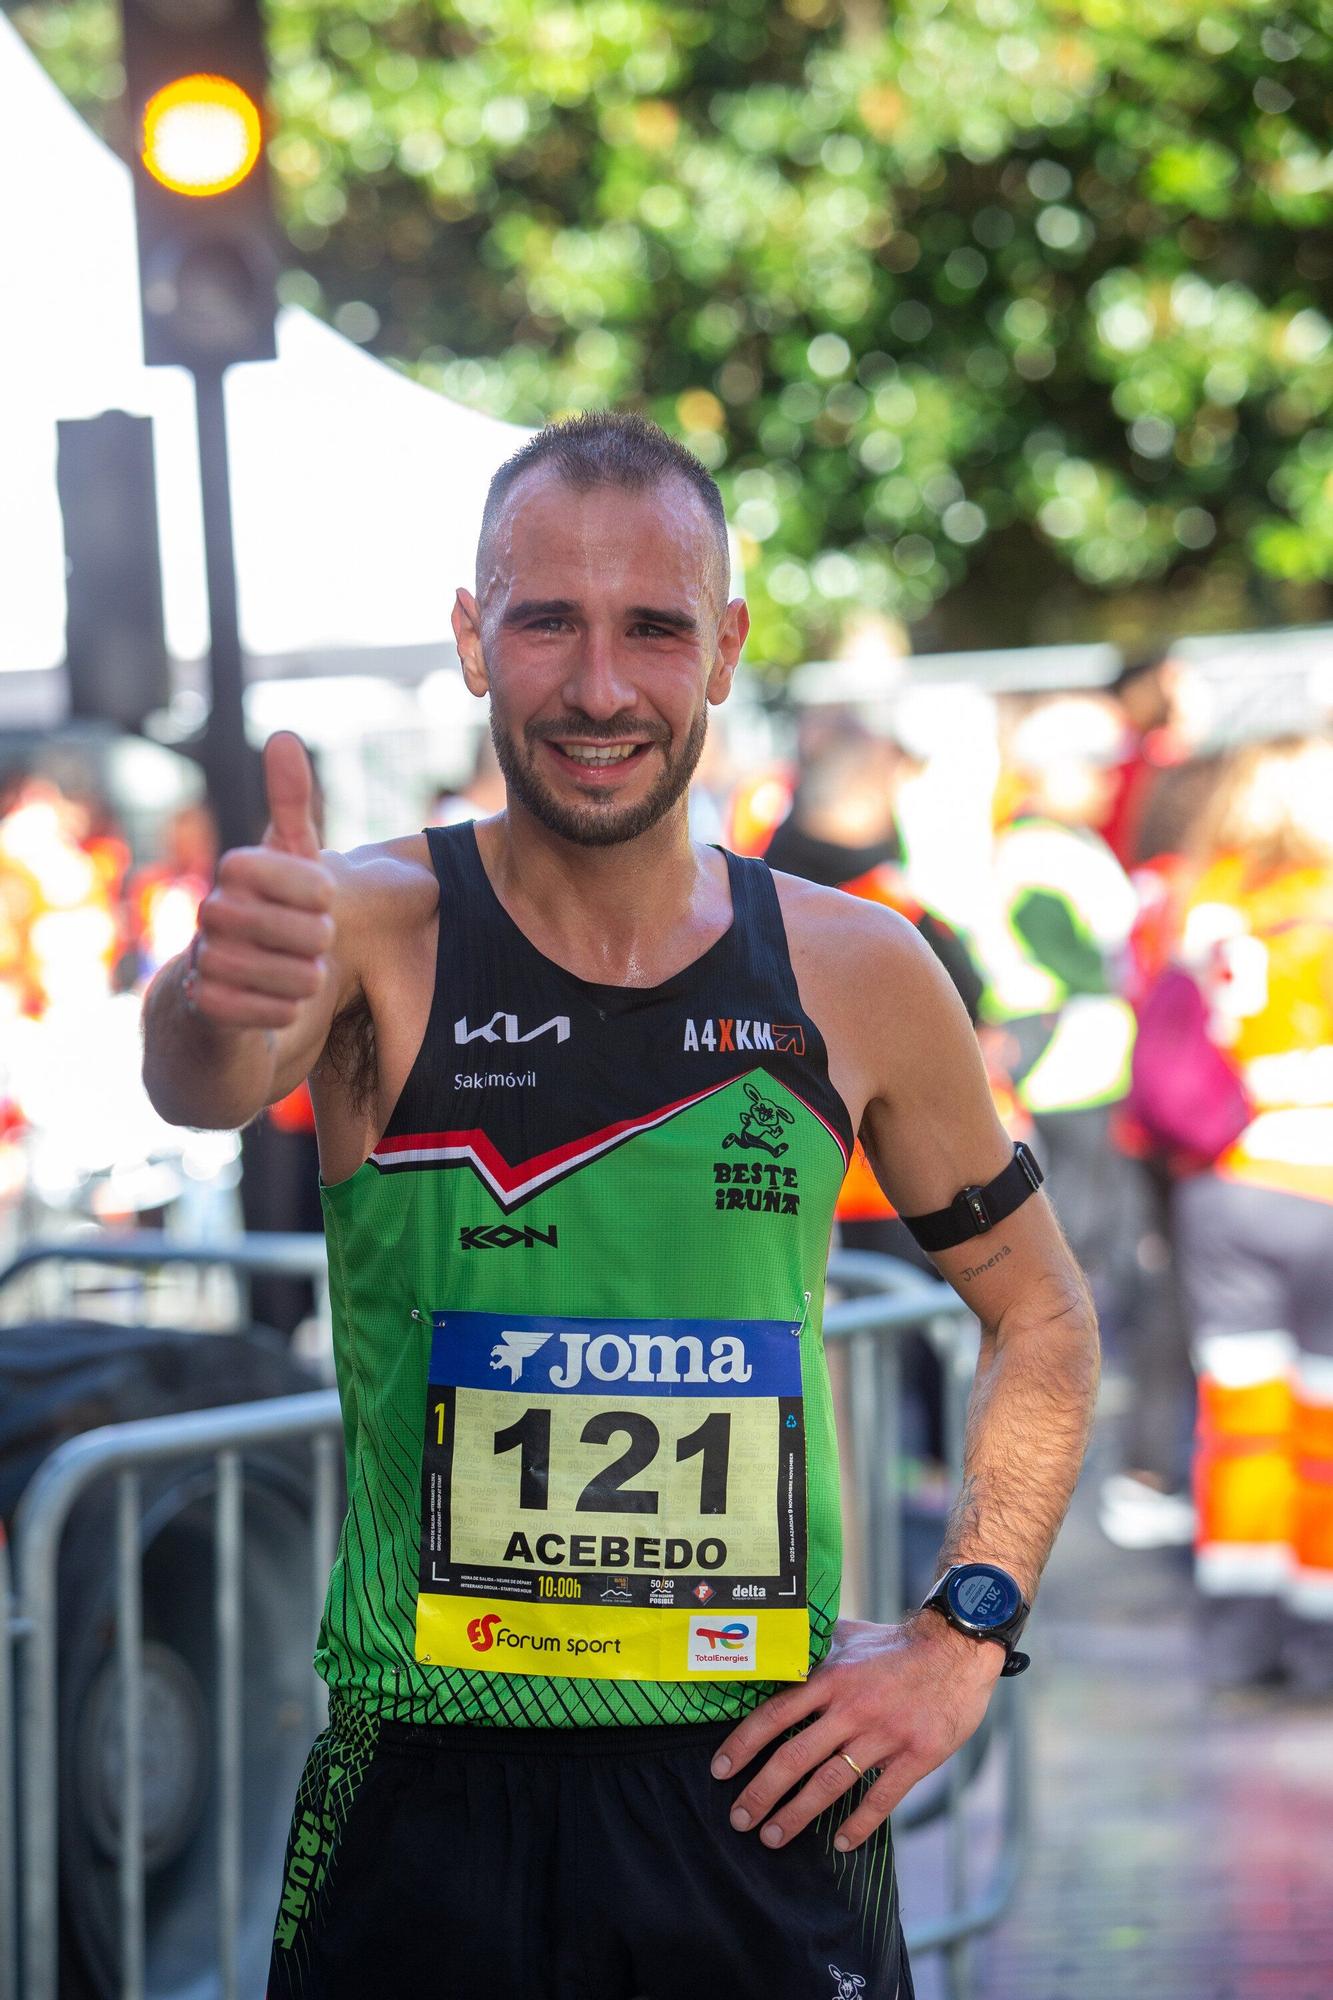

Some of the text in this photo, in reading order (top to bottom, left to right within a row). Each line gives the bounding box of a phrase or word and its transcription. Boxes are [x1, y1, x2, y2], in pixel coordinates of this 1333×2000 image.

[684, 1018, 774, 1052] A4XKM
[454, 1071, 536, 1090] Sakimóvil
[713, 1162, 799, 1188] BESTE
[458, 1224, 558, 1250] KON
[434, 1403, 445, 1445] 1
[494, 1408, 732, 1514] 121
[503, 1532, 727, 1570] ACEBEDO
[539, 1576, 582, 1599] 10:00h
[650, 1578, 675, 1588] 50/50
[732, 1585, 766, 1597] delta
[567, 1638, 621, 1655] sport
[695, 1654, 749, 1664] TotalEnergies
